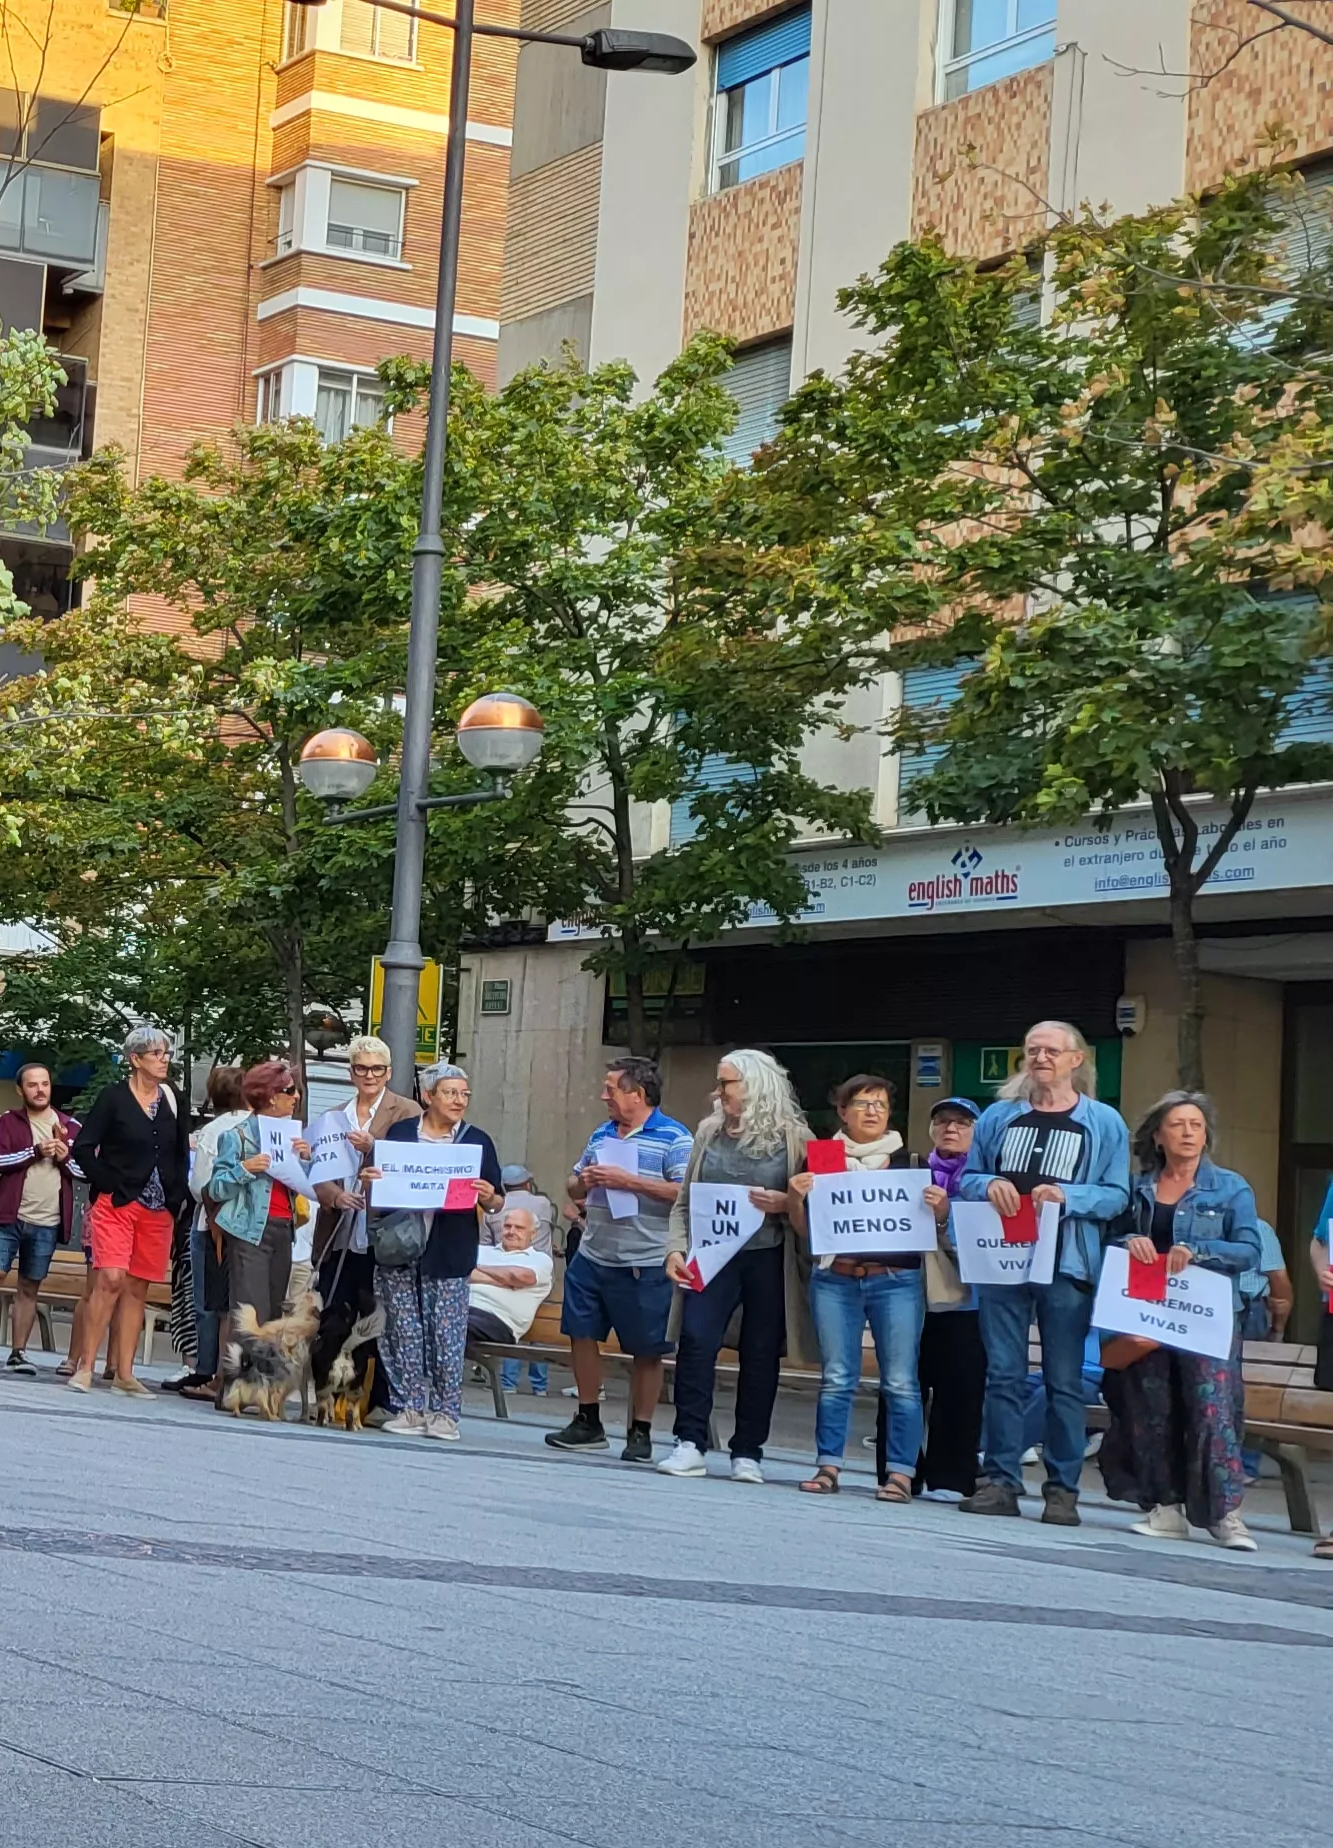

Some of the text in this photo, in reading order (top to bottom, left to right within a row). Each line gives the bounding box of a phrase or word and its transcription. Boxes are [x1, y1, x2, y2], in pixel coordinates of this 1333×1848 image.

[1064, 833, 1109, 848] Cursos
[1113, 833, 1121, 847] y
[1126, 827, 1185, 843] Práca
[1268, 818, 1284, 828] en
[1064, 856, 1074, 867] el
[1079, 852, 1144, 869] extranjero
[1206, 843, 1238, 855] to
[1244, 838, 1255, 851] el
[1261, 836, 1287, 849] año
[801, 857, 878, 873] sde los 4 años
[841, 874, 876, 887] C1-C2)
[1095, 866, 1254, 889] info@engliss.com
[908, 869, 1018, 911] english maths
[270, 1130, 281, 1145] NI
[315, 1152, 338, 1163] ATA
[382, 1163, 474, 1174] EL MACHISMO
[410, 1181, 445, 1191] MATA
[831, 1187, 910, 1205] NI UNA
[715, 1199, 737, 1216] NI
[712, 1219, 740, 1236] UN
[833, 1217, 913, 1235] MENOS
[1167, 1277, 1190, 1291] OS
[1139, 1312, 1188, 1334] VIVAS
